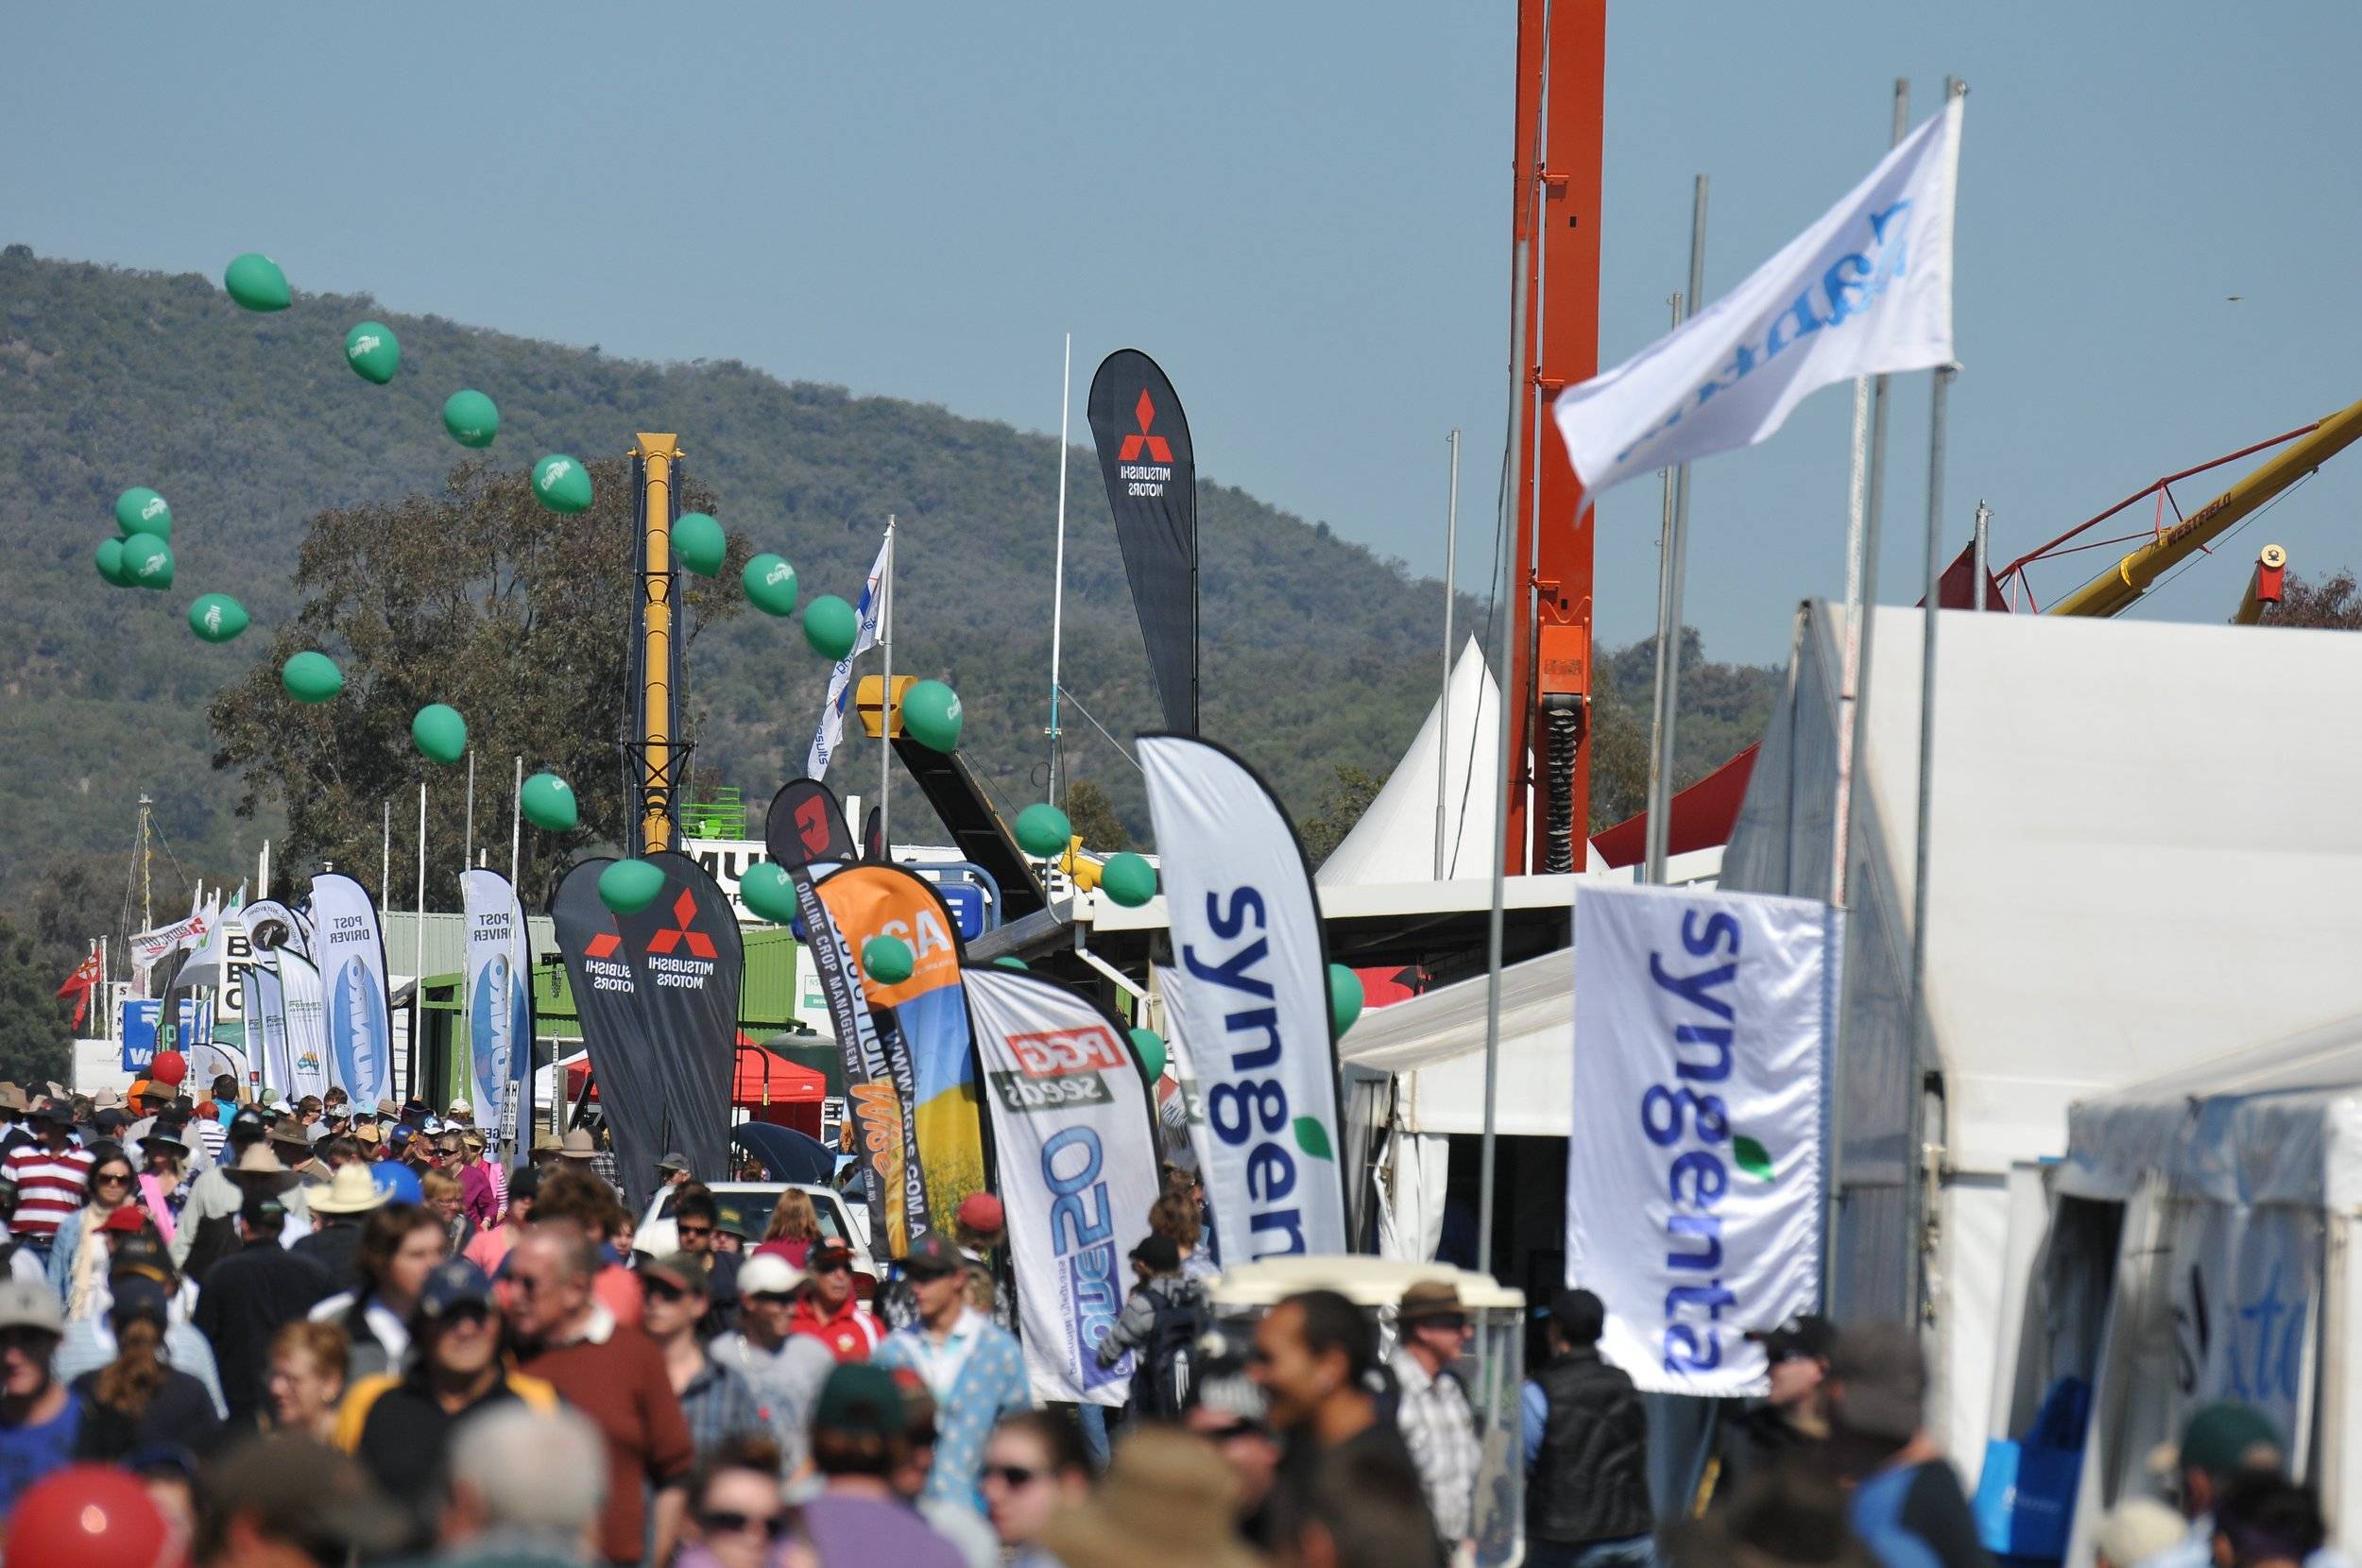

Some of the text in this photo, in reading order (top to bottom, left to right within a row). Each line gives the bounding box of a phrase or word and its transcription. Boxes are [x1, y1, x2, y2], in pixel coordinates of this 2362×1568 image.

[540, 460, 571, 491] Cargill
[796, 881, 825, 933] ONLINE
[815, 935, 839, 972] CROP
[829, 976, 862, 1075] MANAGEMENT
[510, 1102, 516, 1114] 21
[849, 1083, 903, 1180] Wise
[1641, 909, 1743, 1374] syngenta
